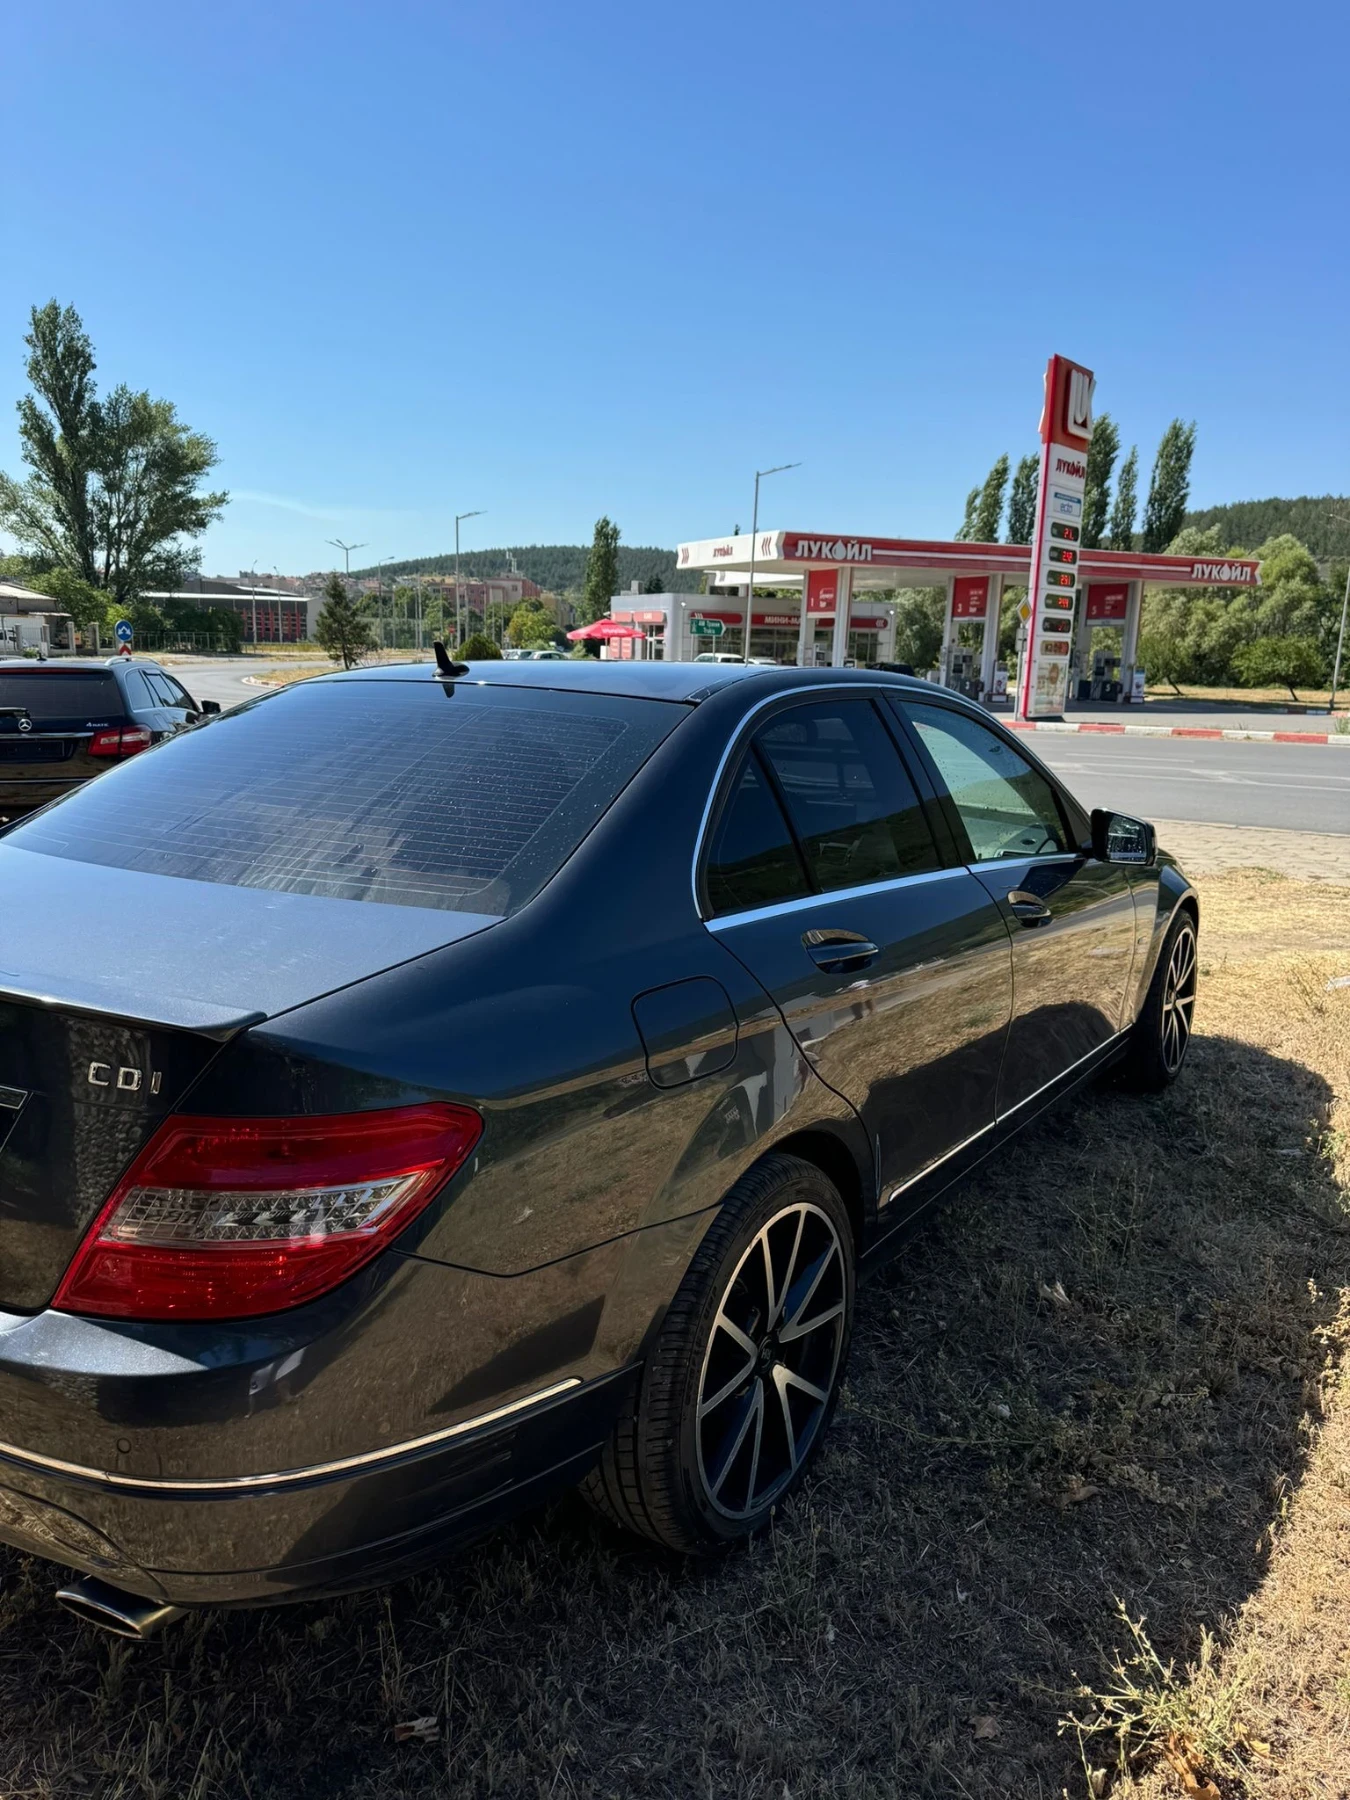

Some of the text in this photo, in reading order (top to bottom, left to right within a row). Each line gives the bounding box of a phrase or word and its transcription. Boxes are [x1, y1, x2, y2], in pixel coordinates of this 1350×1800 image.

[795, 538, 872, 561] ЛУКОЙЛ
[1191, 562, 1251, 581] ЛУКОЙЛ
[88, 1061, 162, 1095] CDI
